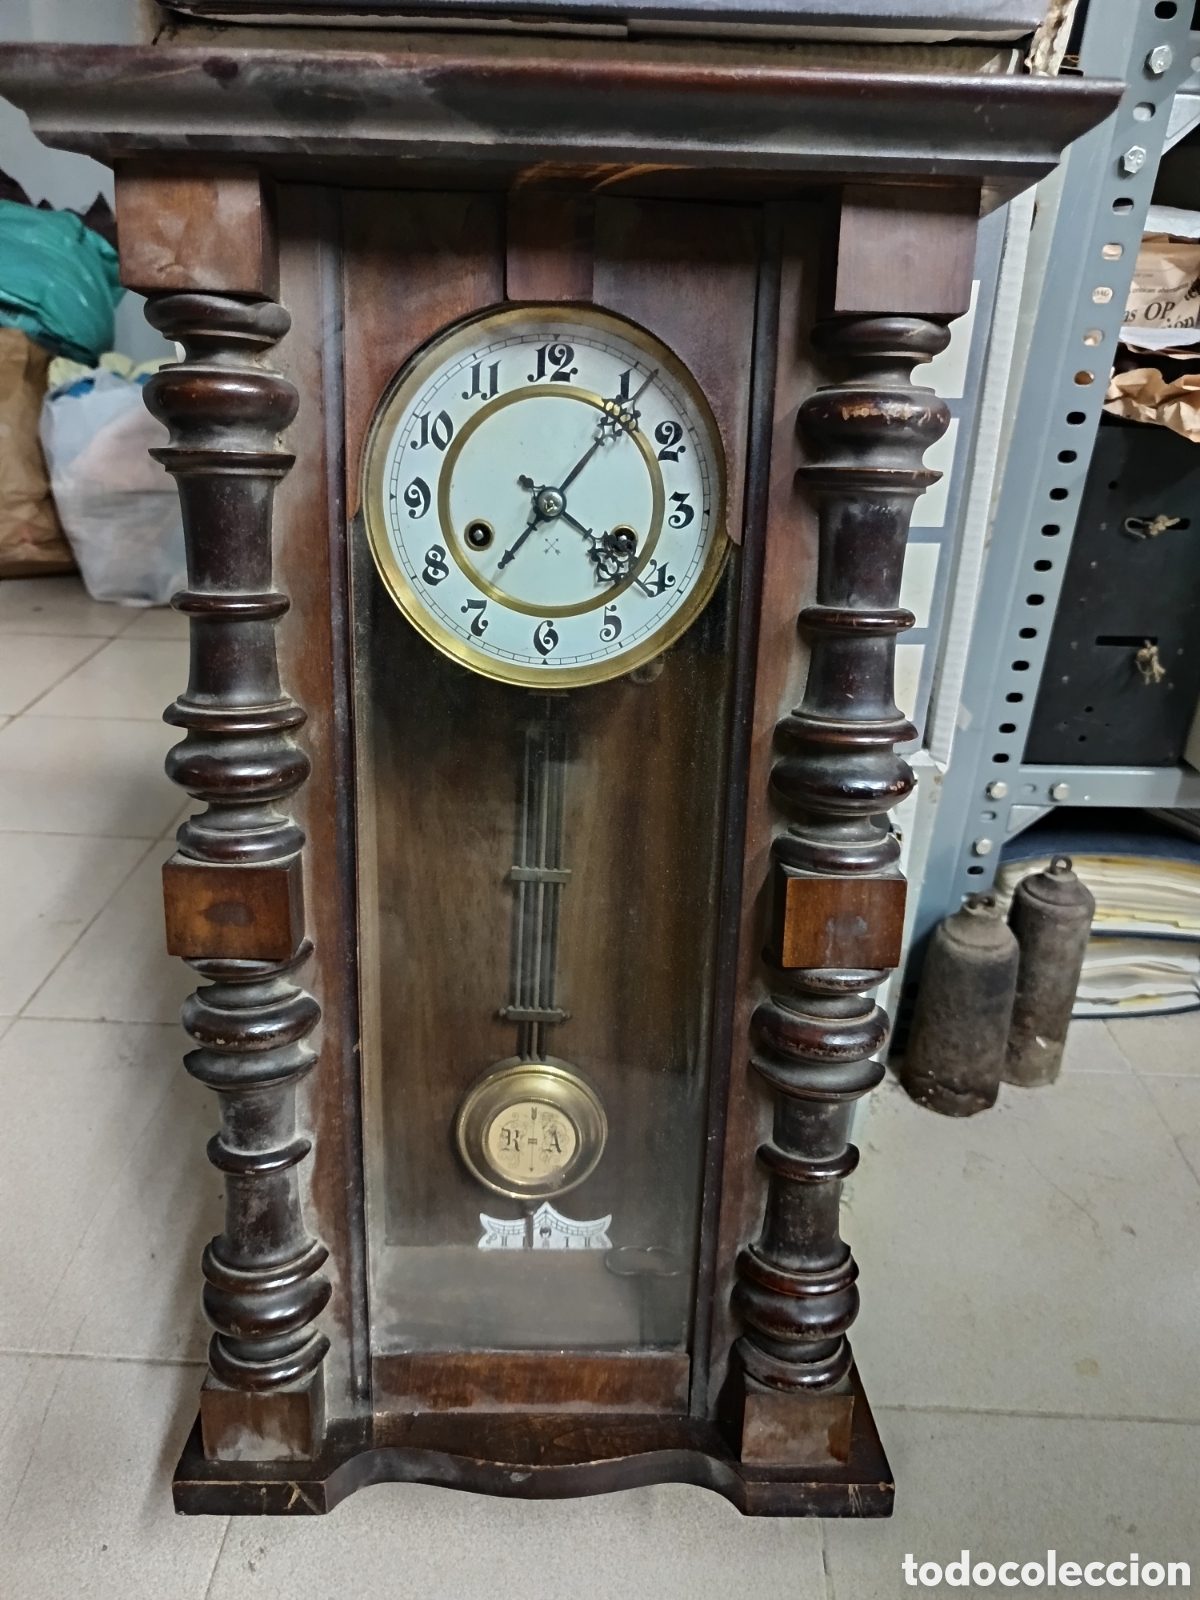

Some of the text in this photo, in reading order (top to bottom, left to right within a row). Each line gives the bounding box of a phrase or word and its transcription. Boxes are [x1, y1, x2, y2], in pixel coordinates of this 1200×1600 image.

[1143, 301, 1176, 321] OP
[461, 359, 502, 401] 11
[527, 343, 578, 383] 12
[618, 368, 634, 400] 1
[410, 409, 454, 452] 10
[654, 420, 686, 463] 2
[403, 476, 431, 519] 9
[668, 491, 695, 529] 3
[422, 543, 450, 586] 8
[642, 558, 676, 598] 4
[460, 598, 489, 637] 7
[533, 619, 559, 656] 6
[598, 604, 622, 642] 5
